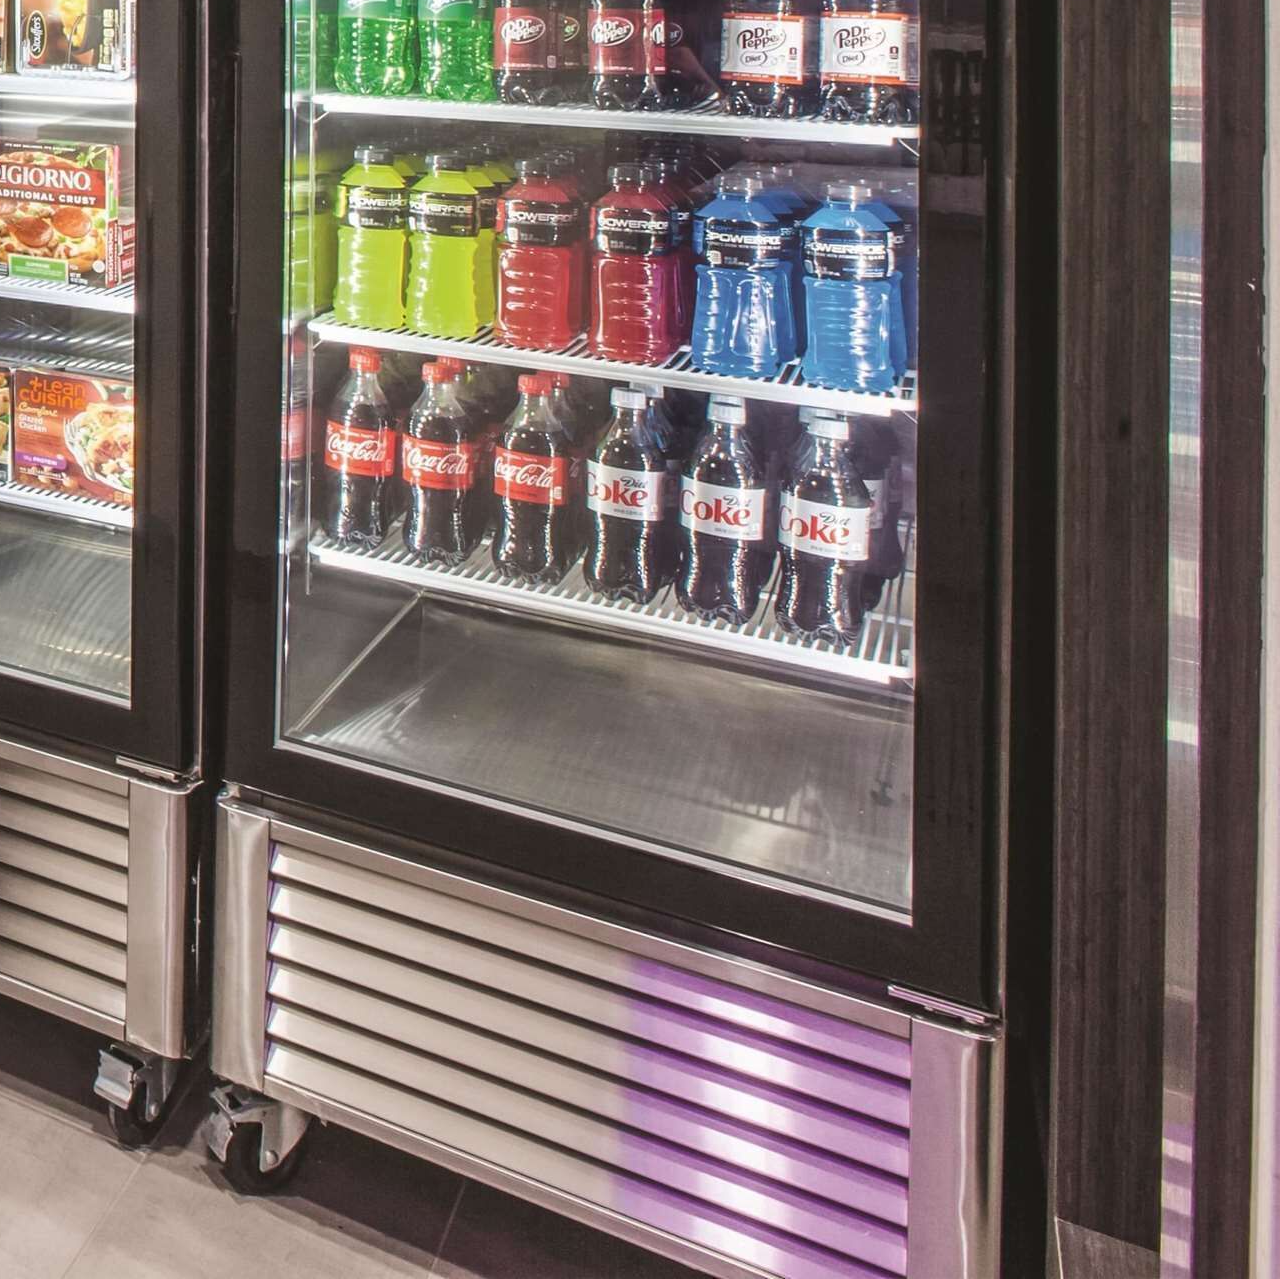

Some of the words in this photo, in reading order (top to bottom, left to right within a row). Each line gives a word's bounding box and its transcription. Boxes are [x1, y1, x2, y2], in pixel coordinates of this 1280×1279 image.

[754, 26, 772, 39] Dr
[849, 25, 868, 38] Dr
[745, 53, 763, 65] Diet
[841, 53, 860, 65] Diet
[58, 194, 97, 205] CRUST
[409, 200, 473, 214] POWERADE
[18, 401, 58, 418] Comfort
[18, 421, 48, 433] Chicken
[327, 432, 386, 462] Coca-Cola
[406, 447, 469, 475] Coca-Cola
[494, 456, 557, 488] Coca-Cola
[586, 471, 649, 509] Coke
[681, 489, 751, 527] Coke
[723, 494, 753, 508] Diet
[779, 504, 851, 546] Coke
[819, 511, 850, 527] Diet
